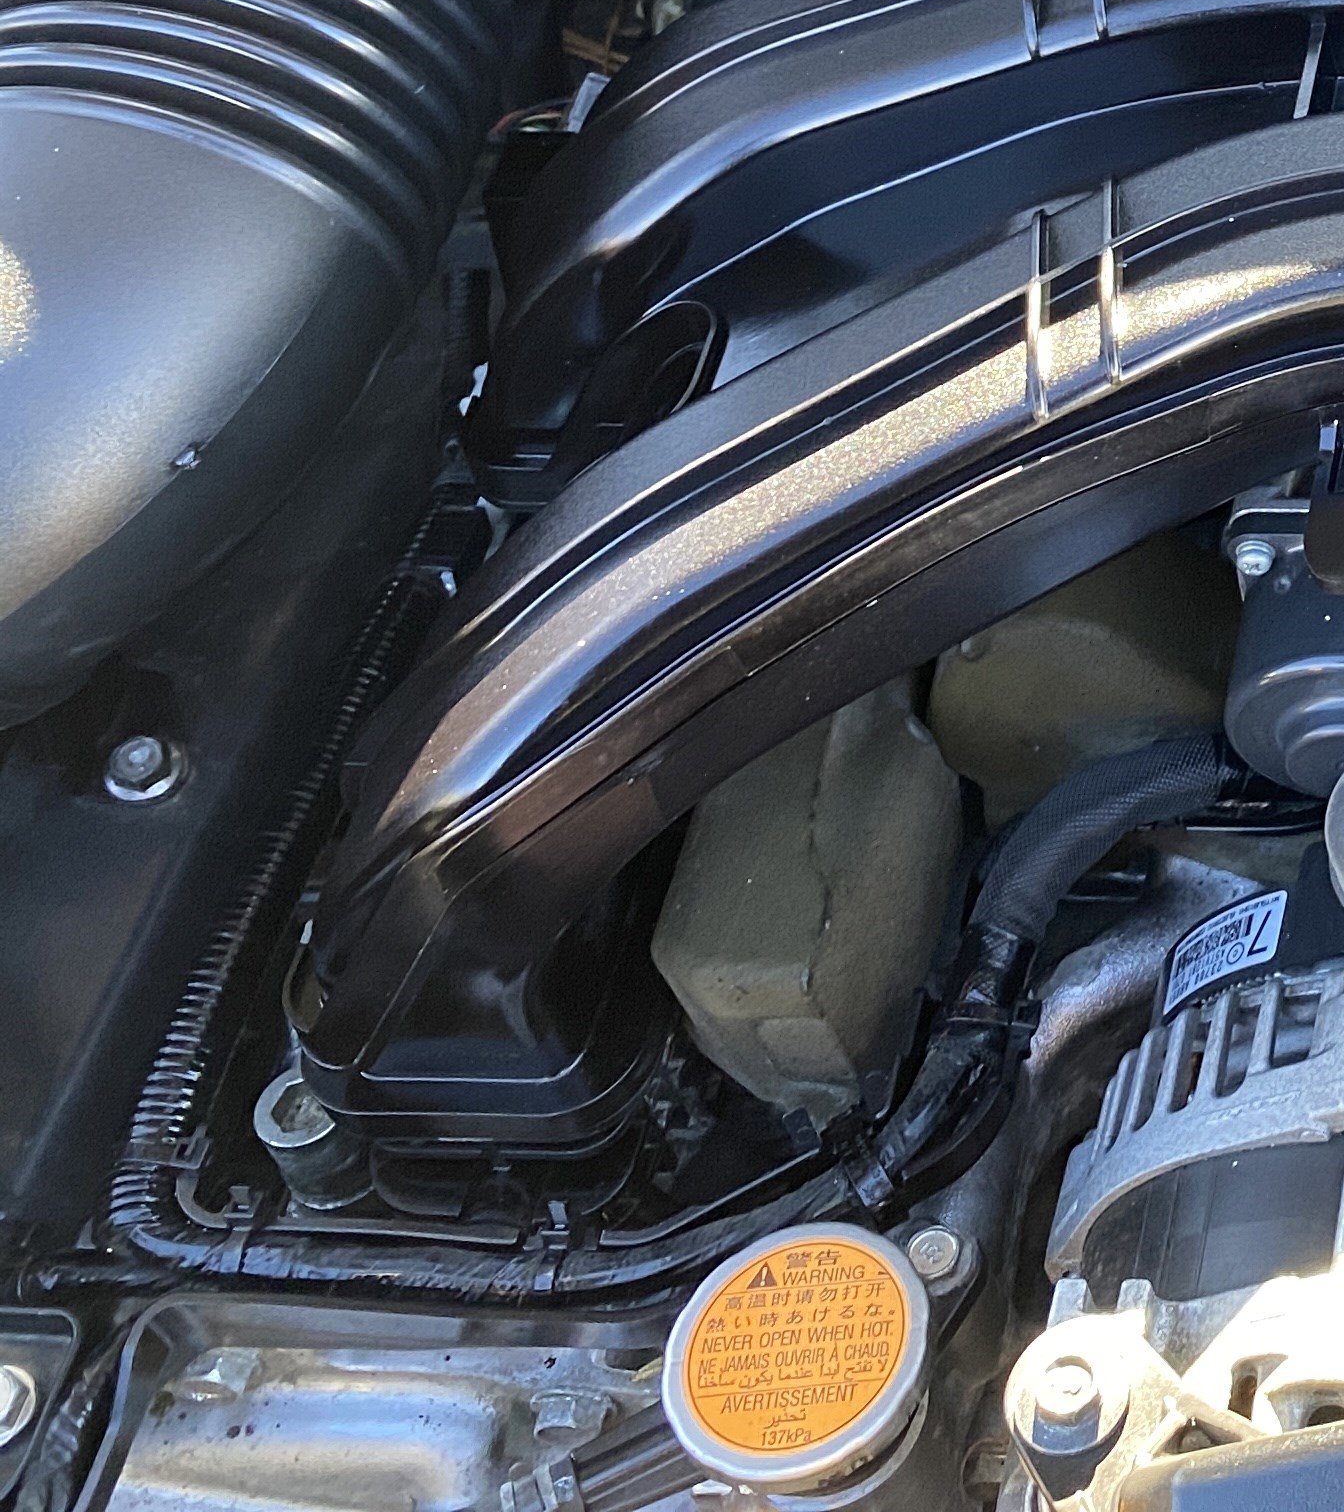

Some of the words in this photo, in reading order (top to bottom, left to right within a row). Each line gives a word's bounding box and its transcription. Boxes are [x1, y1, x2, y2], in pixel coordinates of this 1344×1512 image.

[786, 1249, 842, 1270] 警告
[782, 1265, 866, 1286] WARNING
[701, 1335, 752, 1354] NEVER
[759, 1330, 801, 1348] OPEN
[807, 1324, 854, 1343] WHEN
[860, 1320, 894, 1338] HOT.
[699, 1360, 716, 1376] NE
[720, 1353, 770, 1373] JAMAIS
[775, 1347, 825, 1367] OUVRIR
[829, 1343, 840, 1363] À
[844, 1341, 890, 1361] CHAUD.
[720, 1383, 858, 1414] AVERTISSEMENT
[761, 1427, 812, 1447] 137kPa
